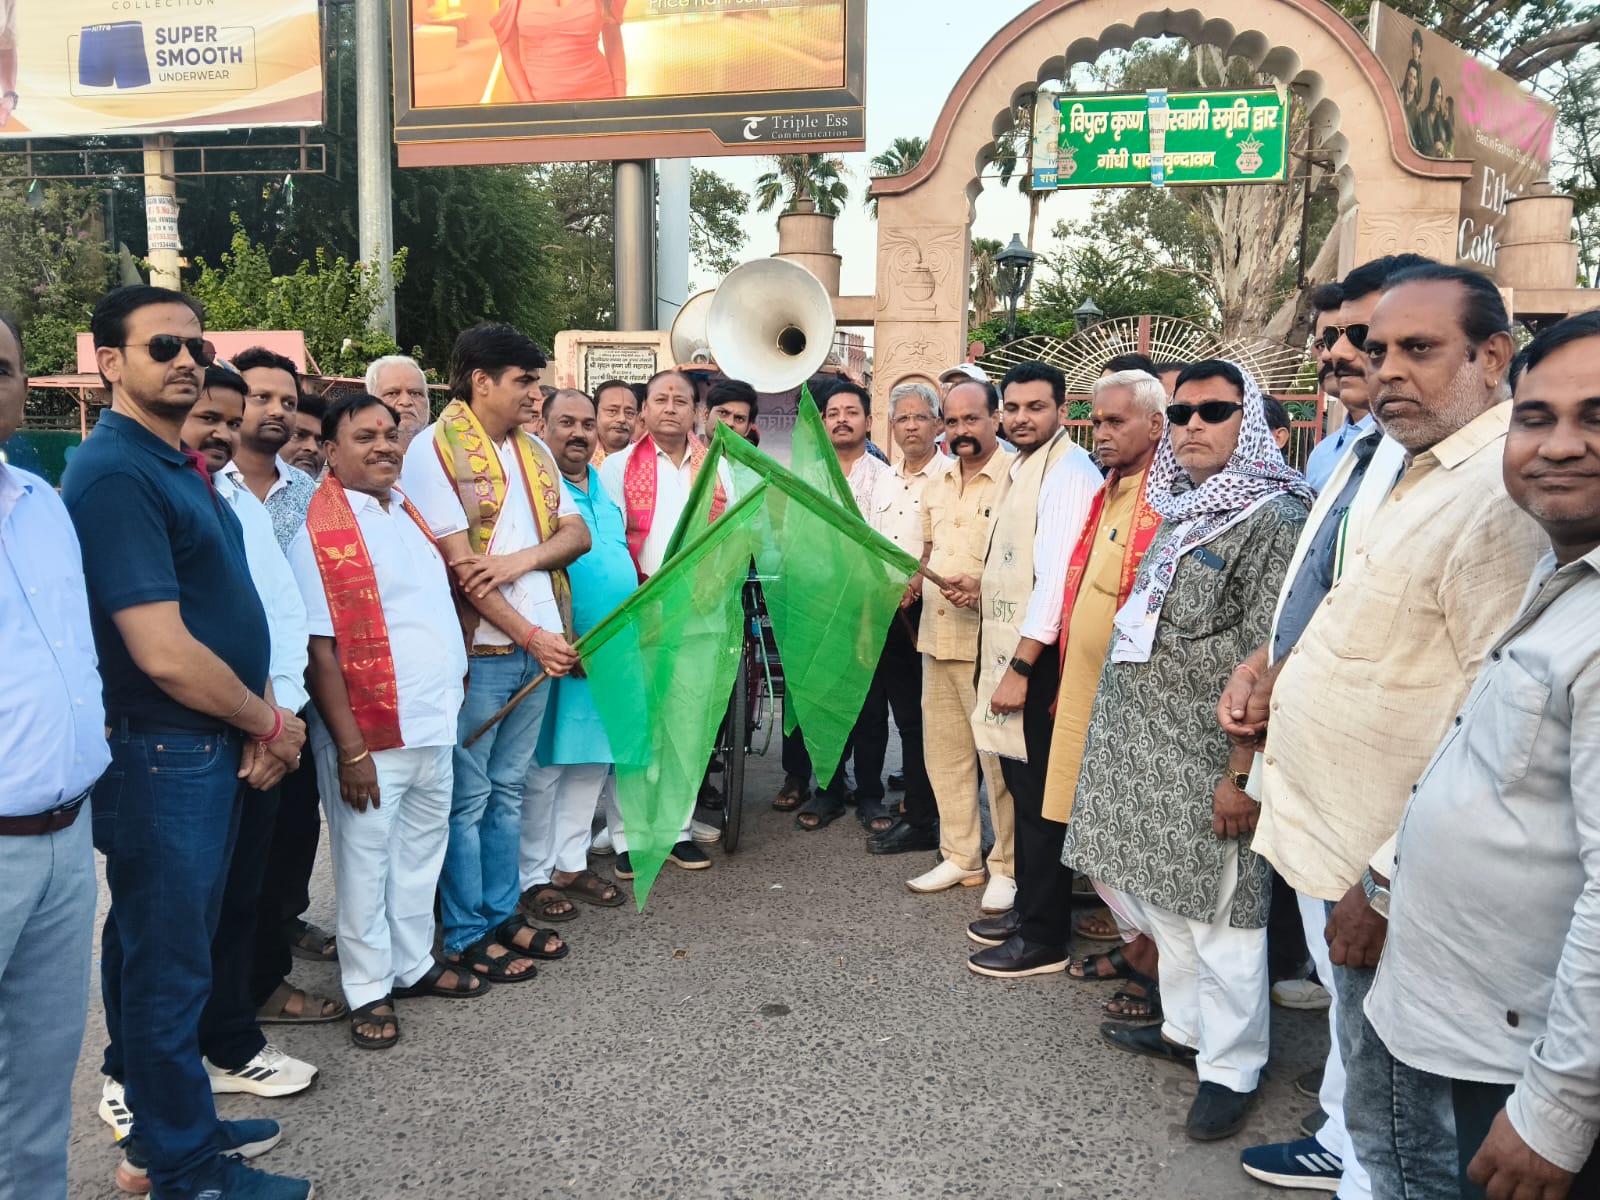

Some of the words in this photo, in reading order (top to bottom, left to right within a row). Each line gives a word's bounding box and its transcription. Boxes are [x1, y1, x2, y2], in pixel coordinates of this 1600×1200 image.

[112, 0, 215, 10] COLLECTION
[155, 25, 218, 45] SUPER
[155, 46, 243, 67] SMOOTH
[158, 69, 230, 82] UNDERWEAR
[771, 114, 819, 132] Triple
[826, 113, 849, 127] Ess
[1070, 103, 1108, 142] विपुल
[1110, 109, 1147, 141] कृष्ण
[1211, 98, 1251, 139] स्मृति
[1251, 105, 1280, 130] द्वार
[771, 130, 849, 140] Communication
[1097, 148, 1129, 169] गाँधी
[1163, 152, 1215, 173] वृन्दावन
